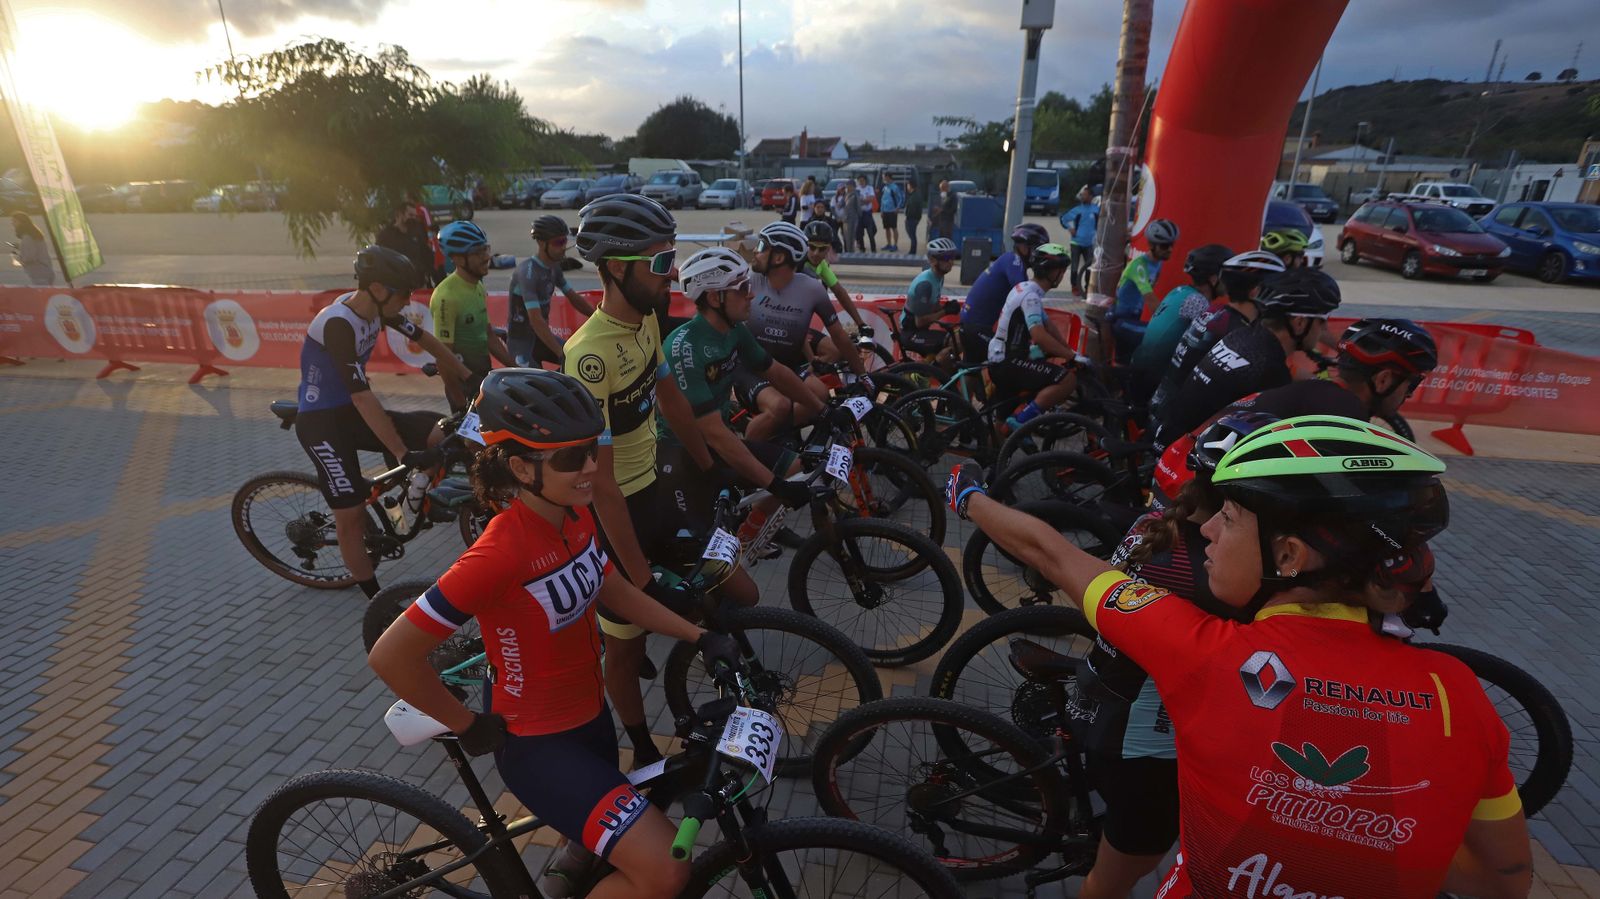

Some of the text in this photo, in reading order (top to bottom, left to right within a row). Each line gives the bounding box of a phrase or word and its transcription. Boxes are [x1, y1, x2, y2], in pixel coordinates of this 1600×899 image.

[1418, 375, 1559, 399] LEGACIÓN DE DEPORTES
[1449, 364, 1519, 381] Ayuntamiento
[1520, 370, 1535, 382] de
[1536, 371, 1555, 383] San
[1557, 373, 1592, 387] Roque
[313, 440, 354, 494] Trimar
[1349, 459, 1388, 469] ABUS
[545, 549, 604, 615] UCA
[1304, 677, 1434, 710] RENAULT
[1303, 698, 1410, 724] Passion for life
[744, 721, 774, 769] 333
[1250, 766, 1290, 788] LOS
[598, 785, 646, 831] UCA
